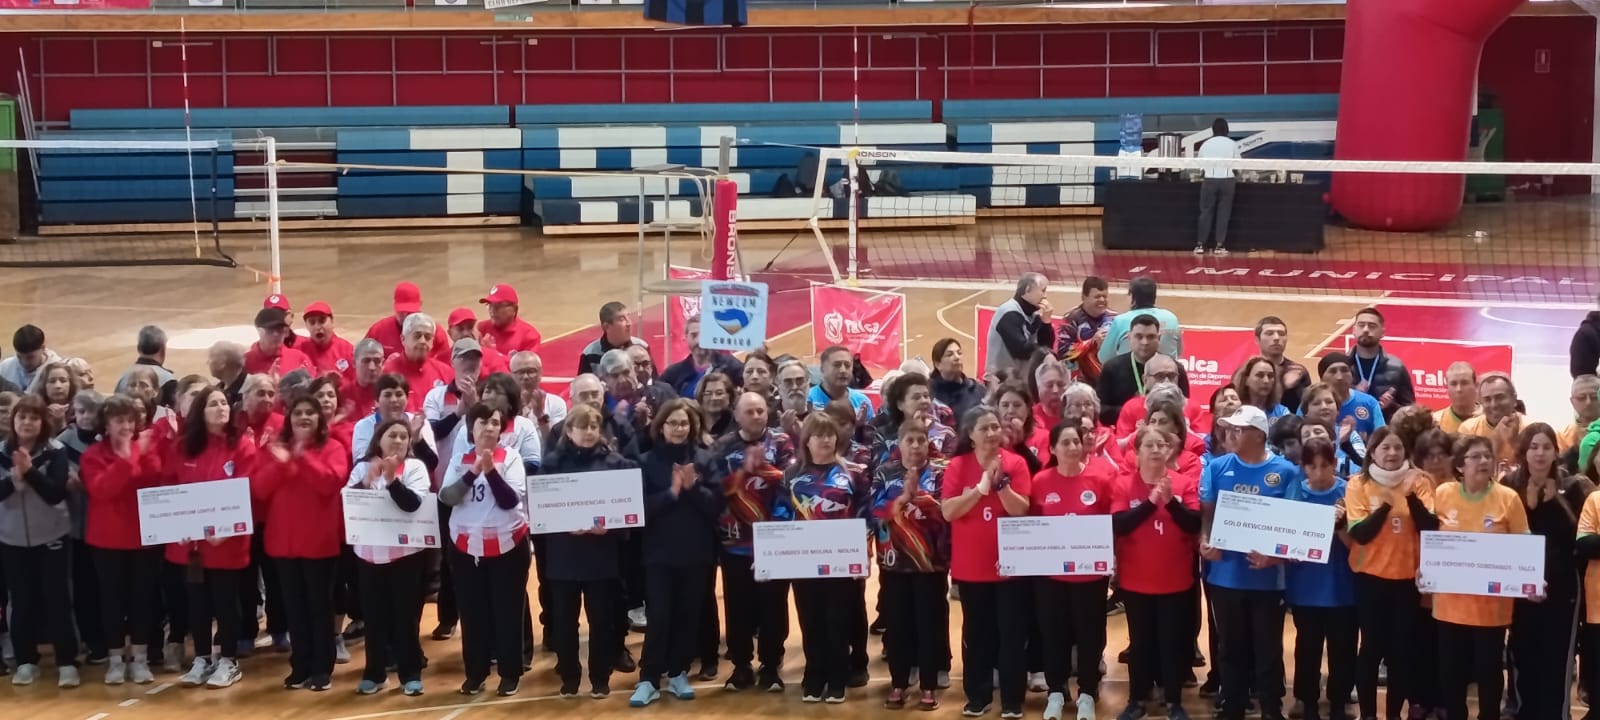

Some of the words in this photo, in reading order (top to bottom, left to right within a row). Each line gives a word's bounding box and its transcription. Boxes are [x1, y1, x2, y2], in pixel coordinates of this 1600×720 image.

[726, 210, 737, 278] BRONS
[1186, 266, 1595, 286] MUNICIPAL
[1176, 355, 1218, 373] alca
[1411, 369, 1448, 386] Tal
[471, 483, 485, 502] 13
[1233, 483, 1260, 494] GOLD
[983, 507, 992, 521] 6
[1154, 520, 1164, 535] 4
[1223, 519, 1242, 528] GOLD
[1242, 521, 1273, 532] NEWCOM
[1274, 526, 1297, 535] RETIRO
[1302, 530, 1326, 539] RETIRO
